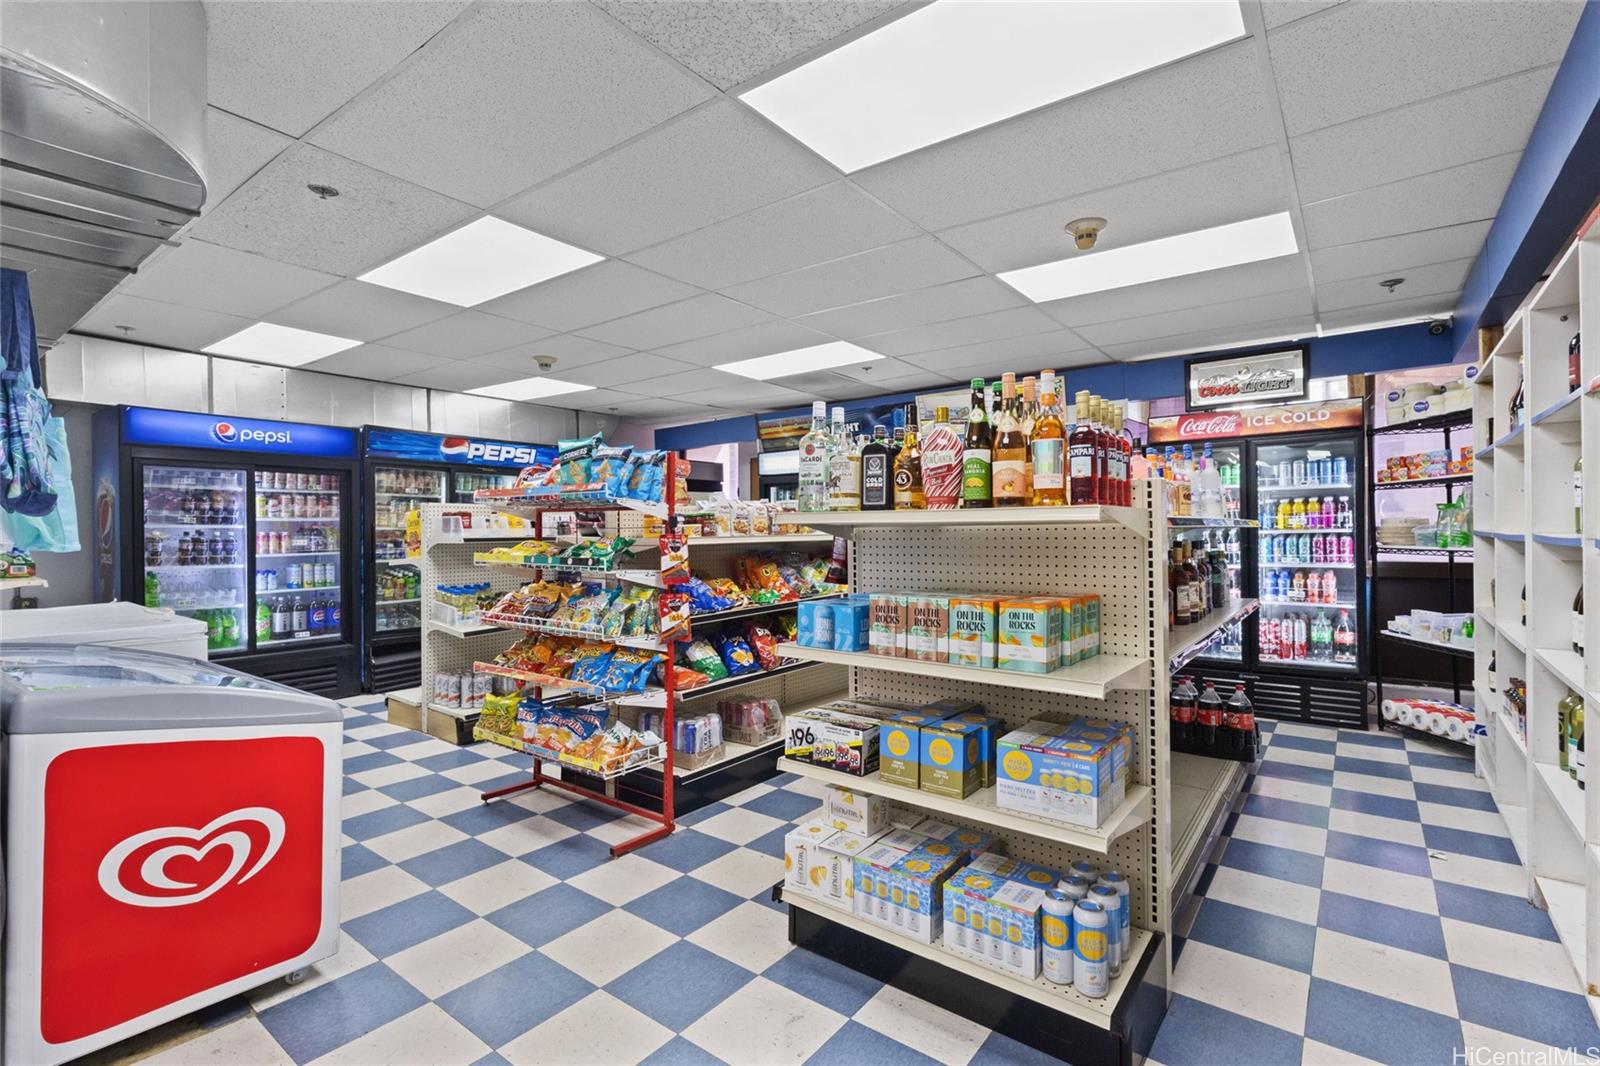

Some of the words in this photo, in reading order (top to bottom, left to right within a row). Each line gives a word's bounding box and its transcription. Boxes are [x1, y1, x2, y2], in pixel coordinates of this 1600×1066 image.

[1199, 384, 1240, 398] Coors
[1240, 377, 1294, 393] LIGHT
[1180, 415, 1238, 436] Coca-Cola
[1247, 415, 1275, 427] ICE
[1281, 410, 1331, 424] COLD
[240, 429, 291, 444] pepsi
[467, 443, 537, 464] PEPSI
[896, 474, 908, 484] 43
[875, 605, 885, 615] ON
[887, 605, 899, 616] THE
[914, 607, 925, 617] ON
[927, 608, 940, 618] THE
[956, 610, 969, 620] ON
[970, 611, 984, 621] THE
[1008, 611, 1020, 620] ON
[1022, 612, 1035, 621] THE
[875, 614, 900, 625] ROCKS
[914, 617, 941, 628] ROCKS
[1008, 620, 1036, 630] ROCKS
[956, 620, 986, 632] ROCKS
